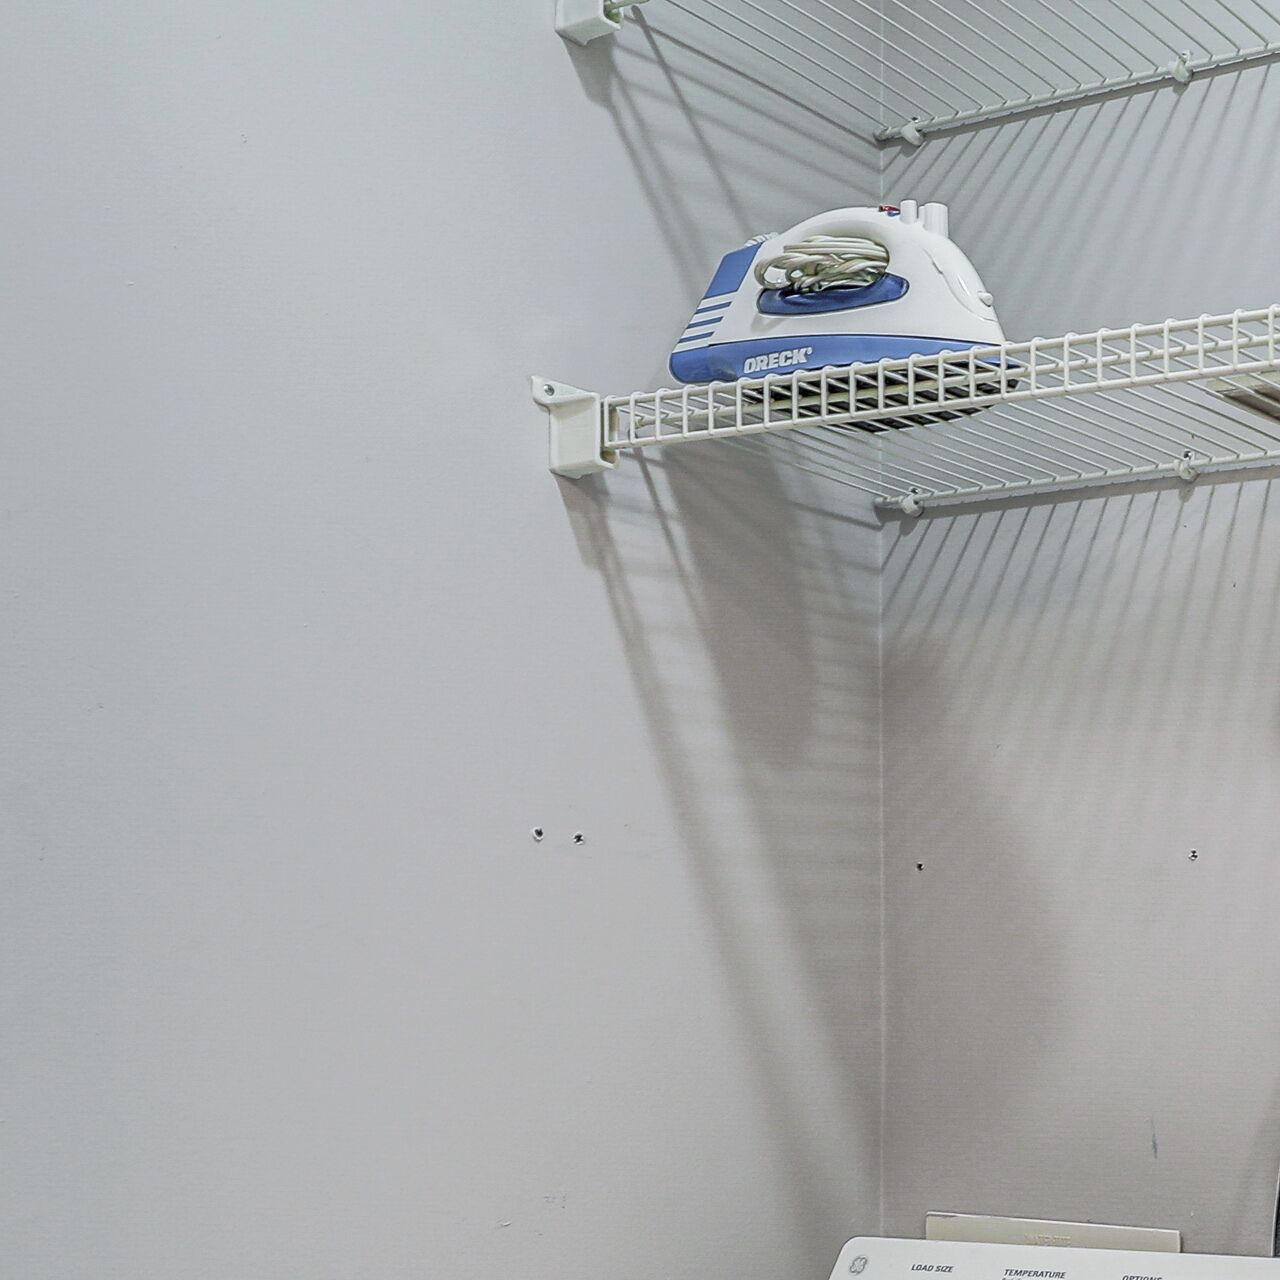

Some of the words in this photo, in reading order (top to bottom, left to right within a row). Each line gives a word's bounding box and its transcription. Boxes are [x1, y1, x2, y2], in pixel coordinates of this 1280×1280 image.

[743, 347, 808, 374] ORECK
[911, 1264, 934, 1272] LOAD
[935, 1265, 953, 1273] SIZE
[1003, 1268, 1067, 1279] TEMPERATURE
